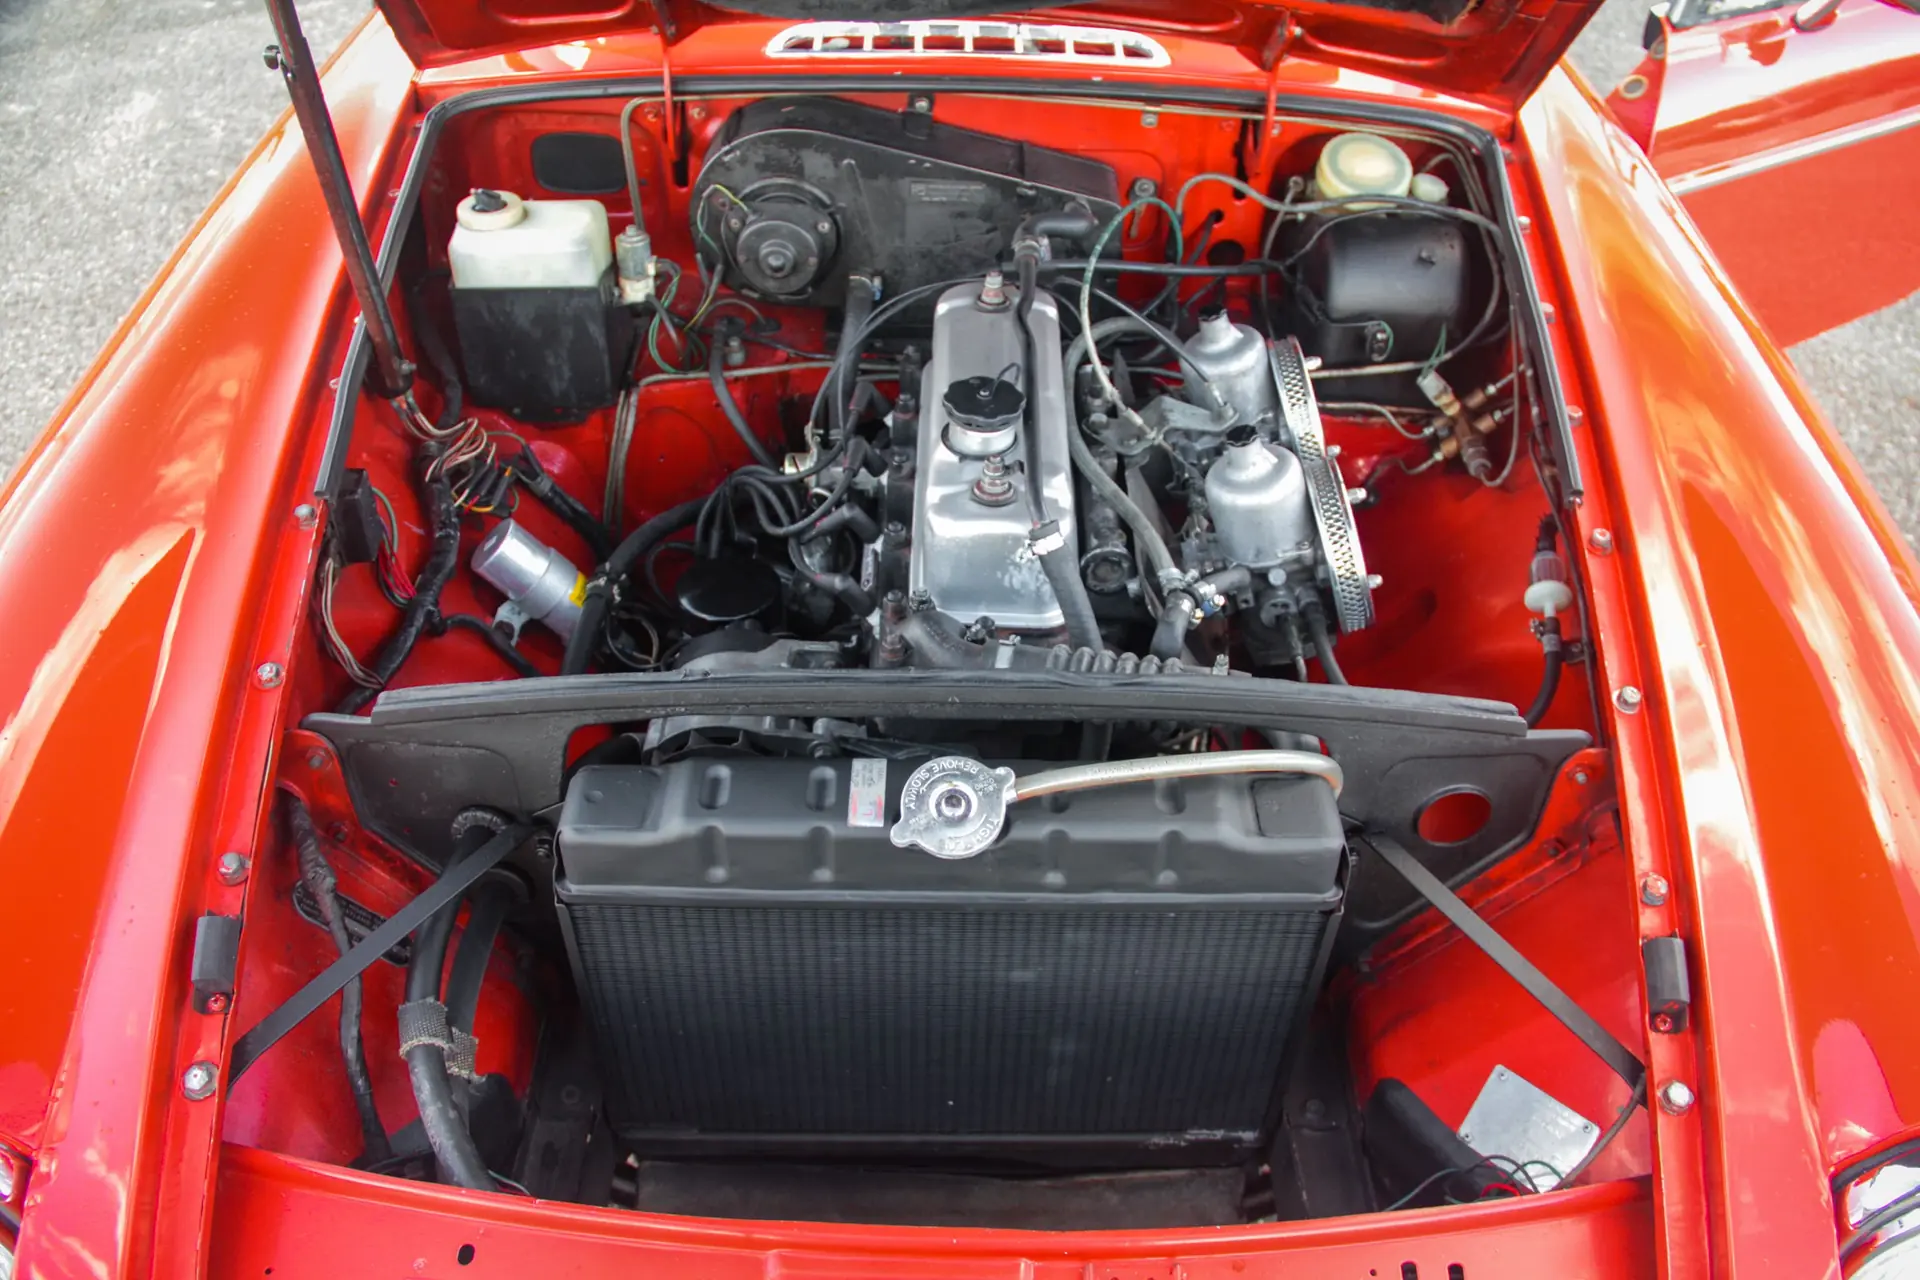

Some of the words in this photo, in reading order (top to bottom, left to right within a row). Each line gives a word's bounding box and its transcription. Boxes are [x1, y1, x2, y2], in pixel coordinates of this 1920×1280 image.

[933, 758, 980, 774] REMOVE
[905, 769, 930, 810] SLOWLY
[944, 817, 1001, 850] TIGHEN
